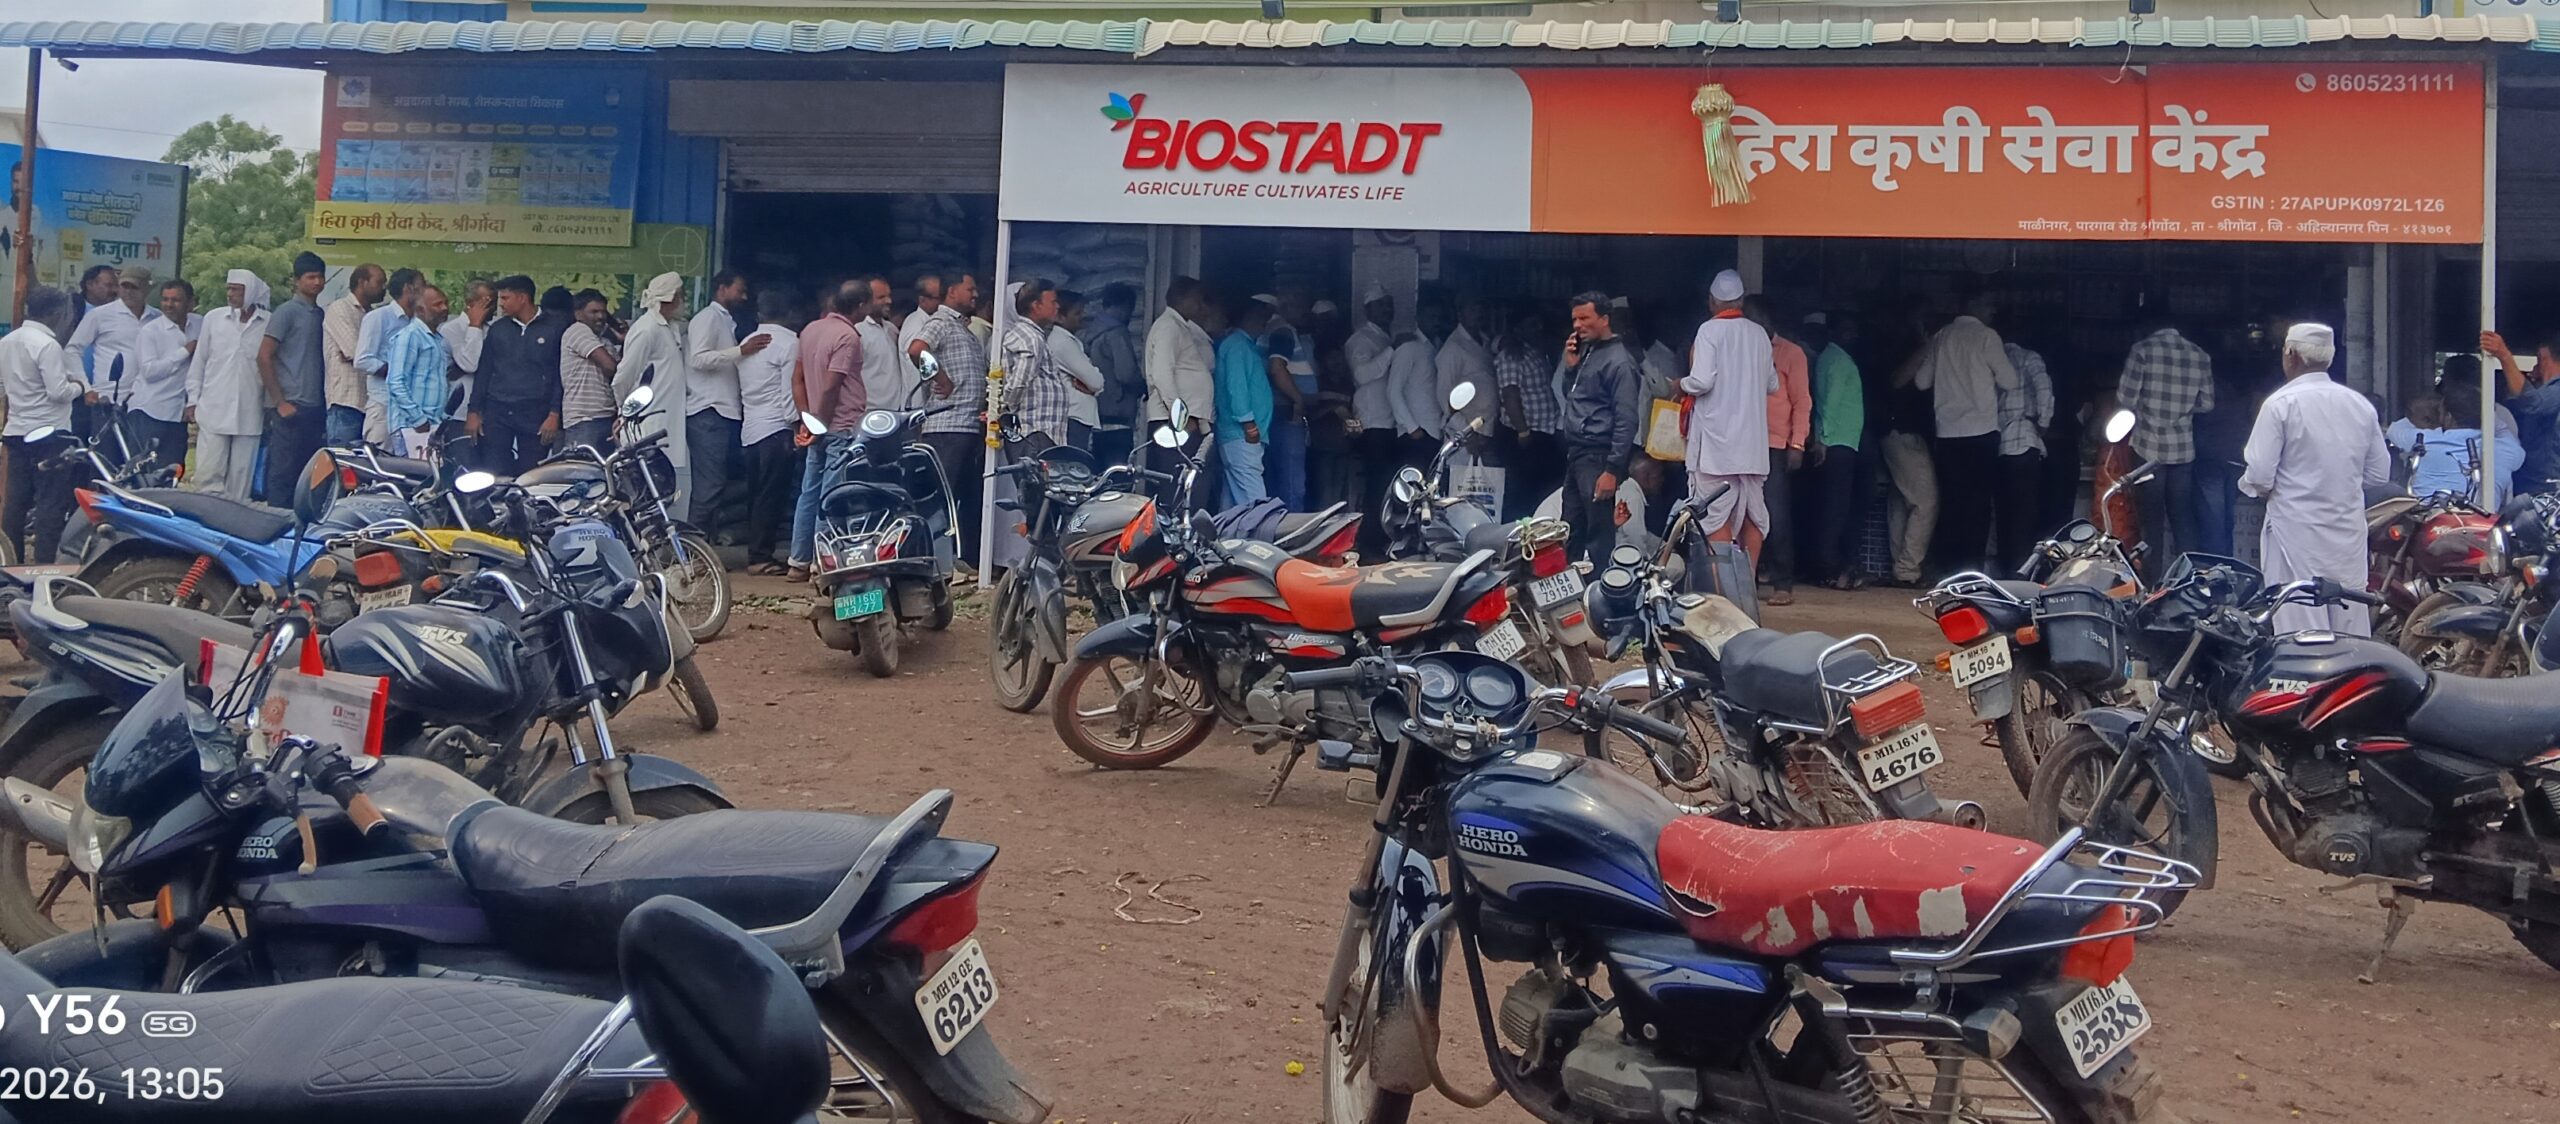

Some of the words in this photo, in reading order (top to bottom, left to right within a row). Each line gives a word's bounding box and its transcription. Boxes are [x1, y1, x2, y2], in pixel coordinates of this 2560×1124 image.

[2326, 73, 2456, 92] 8605231111
[1122, 119, 1443, 175] BIOSTADT
[1848, 106, 1991, 191] कृषी
[2001, 106, 2140, 175] सेवा
[2149, 105, 2270, 180] केंद्र
[1124, 181, 1250, 197] AGRICULTURE
[1255, 183, 1360, 199] CULTIVATES
[1364, 186, 1405, 200] LIFE
[2210, 196, 2264, 209] GSTIN
[2280, 197, 2446, 212] 27APUPK0972L1Z6
[319, 210, 347, 229] हिरा
[350, 212, 383, 234] कृषी
[385, 211, 413, 231] सेवा
[452, 212, 507, 233] श्रीगोंदा
[2018, 217, 2073, 233] माळीनगर,
[2076, 220, 2116, 232] पारगाव
[2119, 218, 2138, 232] रोड
[2191, 220, 2206, 232] ता
[2217, 218, 2258, 232] श्रीगोंदा
[2267, 218, 2285, 232] जि
[2296, 219, 2365, 234] अहिल्यानगर
[2367, 220, 2391, 234] पिन
[2402, 223, 2453, 236] ४१३७०१
[1538, 573, 1570, 592] MH16A
[1542, 584, 1575, 602] Z9198
[844, 601, 876, 617] X3477
[419, 626, 468, 644] TVS
[1956, 651, 2006, 683] L.5094
[2269, 679, 2309, 695] TVS
[1872, 746, 1936, 784] 4676
[242, 836, 273, 848] ERO
[1461, 823, 1519, 843] HERO
[236, 847, 279, 859] ONDA
[1457, 834, 1529, 857] HONDA
[2328, 851, 2357, 863] TVS
[931, 980, 950, 1005] MH
[948, 972, 960, 988] 12
[934, 967, 993, 1044] 6213
[2072, 994, 2144, 1068] 2538
